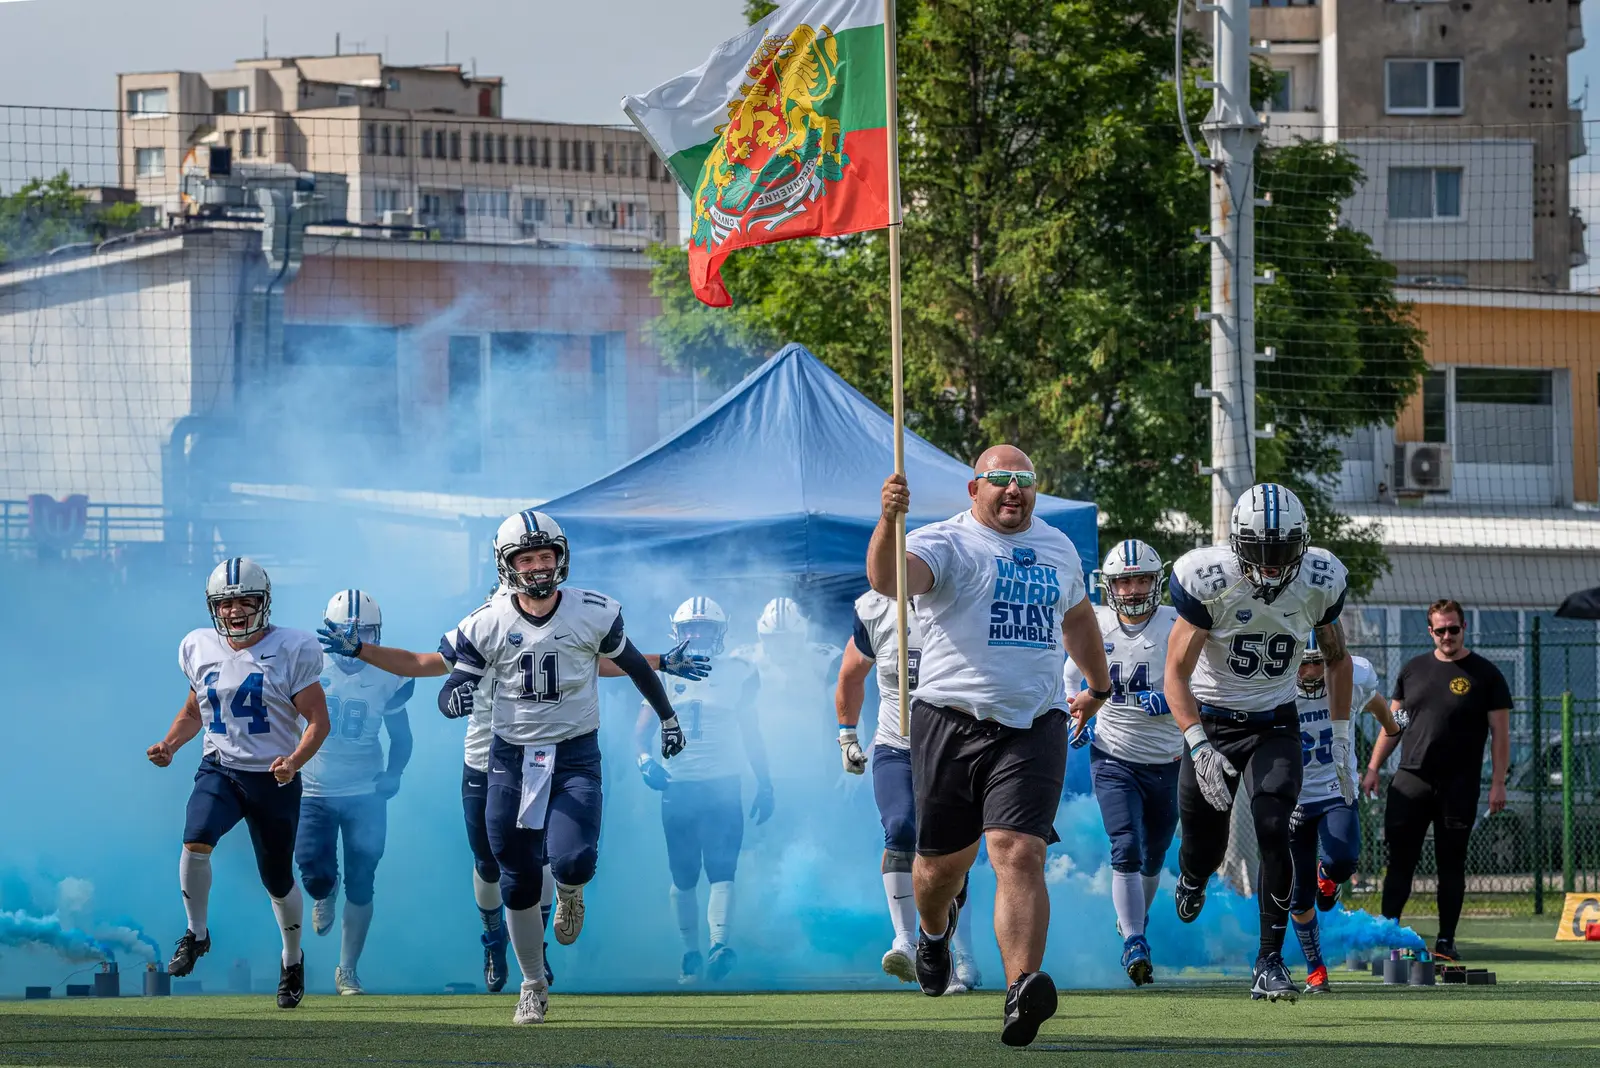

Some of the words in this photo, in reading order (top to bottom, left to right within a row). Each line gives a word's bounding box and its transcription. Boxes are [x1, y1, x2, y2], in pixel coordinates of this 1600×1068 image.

[995, 558, 1060, 587] WORK
[993, 578, 1061, 607] HARD
[990, 601, 1055, 629] STAY
[1226, 631, 1299, 680] 59
[517, 651, 563, 705] 11
[204, 671, 271, 735] 14
